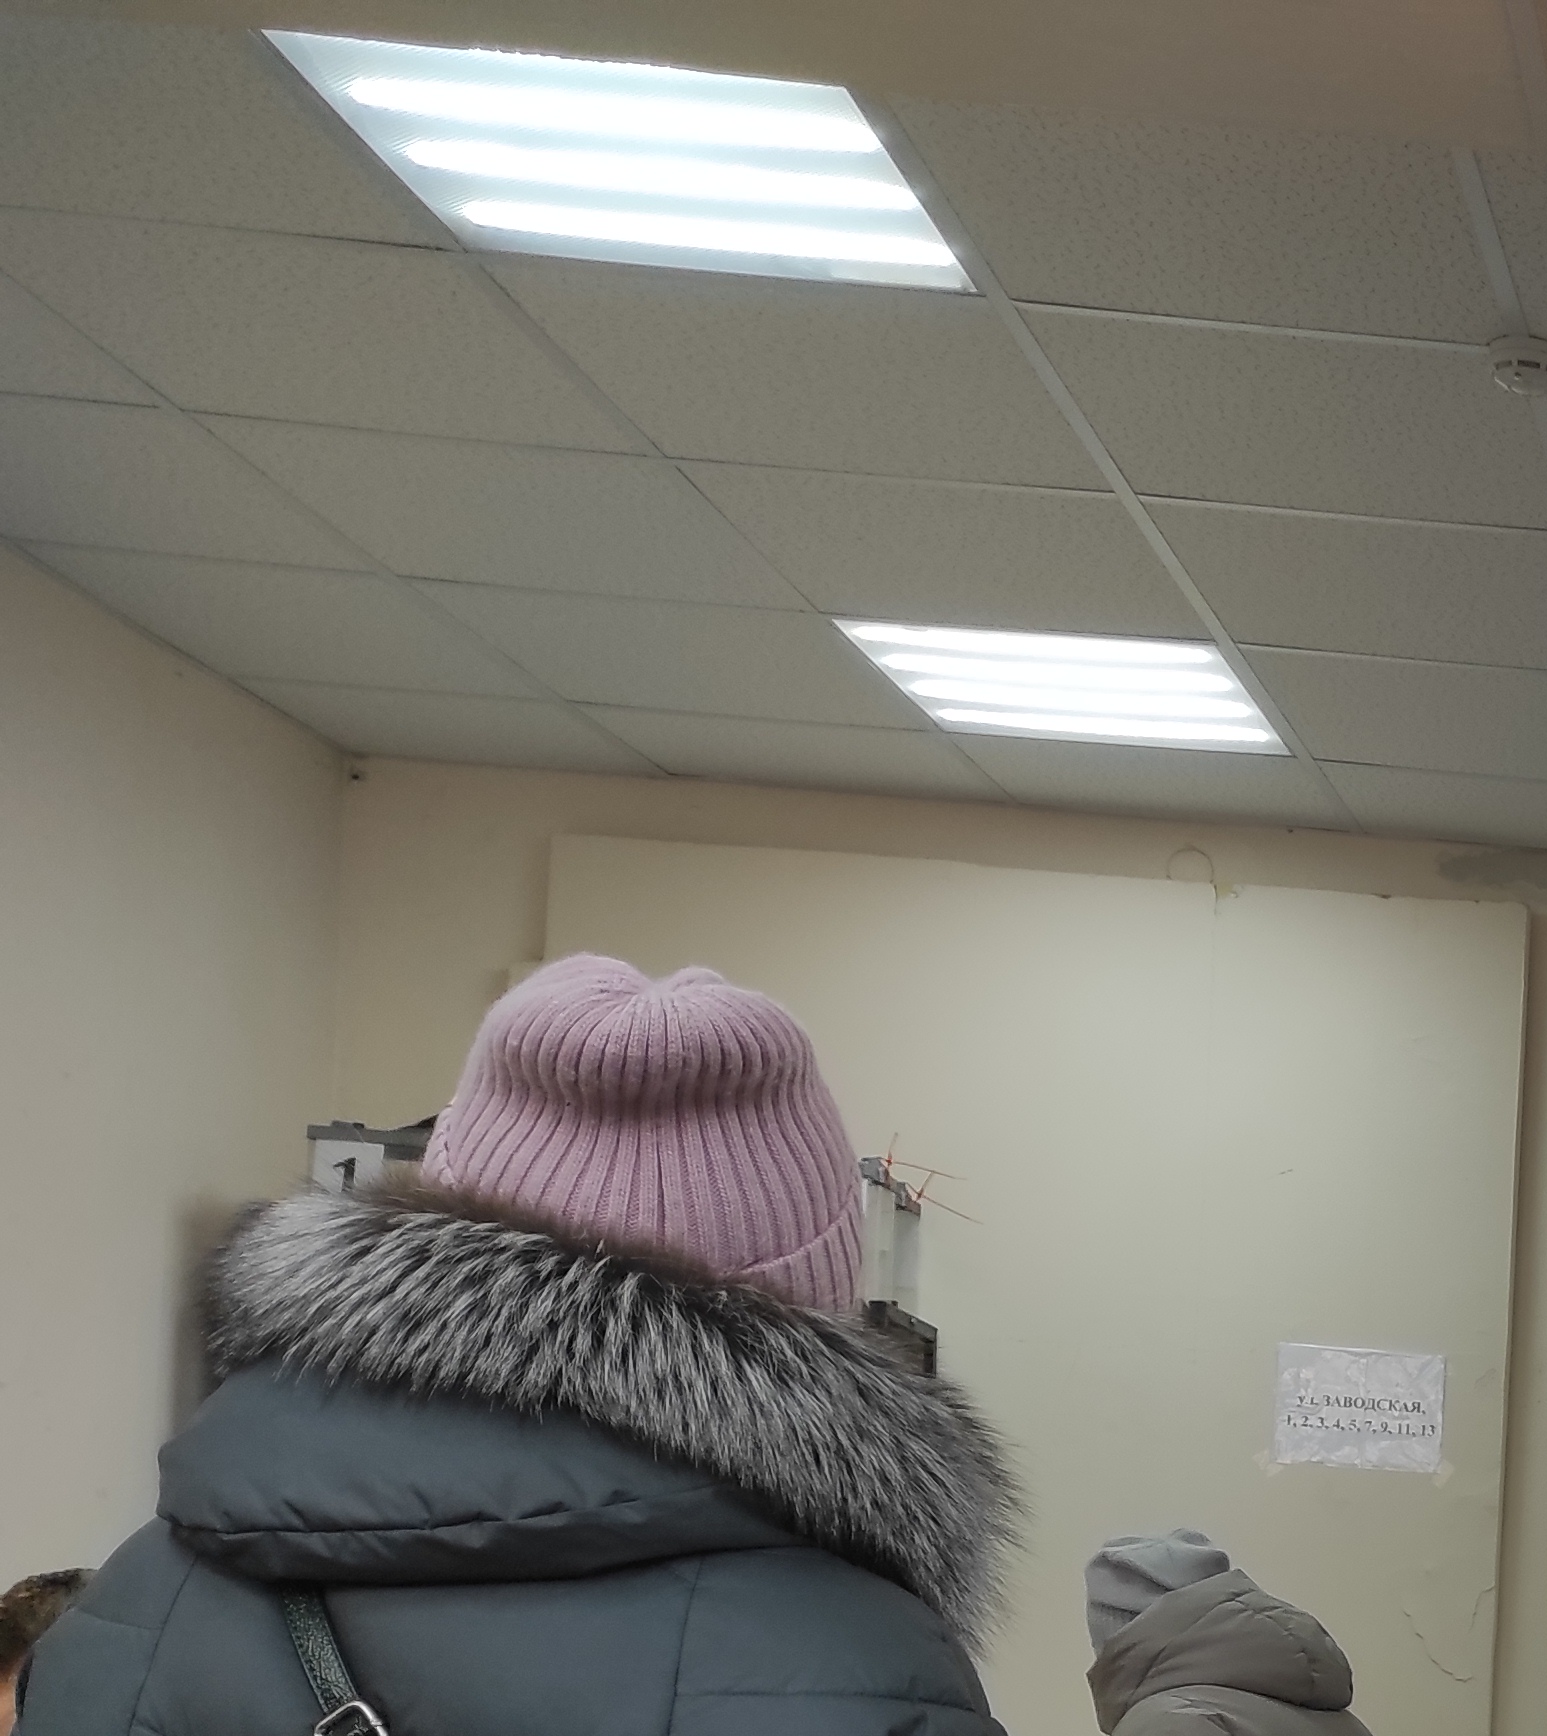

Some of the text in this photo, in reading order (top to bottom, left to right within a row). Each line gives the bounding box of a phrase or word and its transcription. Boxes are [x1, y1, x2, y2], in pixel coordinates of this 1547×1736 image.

[1322, 1394, 1427, 1415] ЗАВОДСКАЯ,
[1301, 1415, 1313, 1428] 2,
[1317, 1416, 1329, 1430] 3,
[1332, 1418, 1345, 1431] 4,
[1348, 1419, 1360, 1432] 5,
[1365, 1420, 1377, 1434] 7,
[1380, 1421, 1393, 1435] 9,
[1396, 1422, 1416, 1437] 11,
[1420, 1424, 1436, 1437] 13
